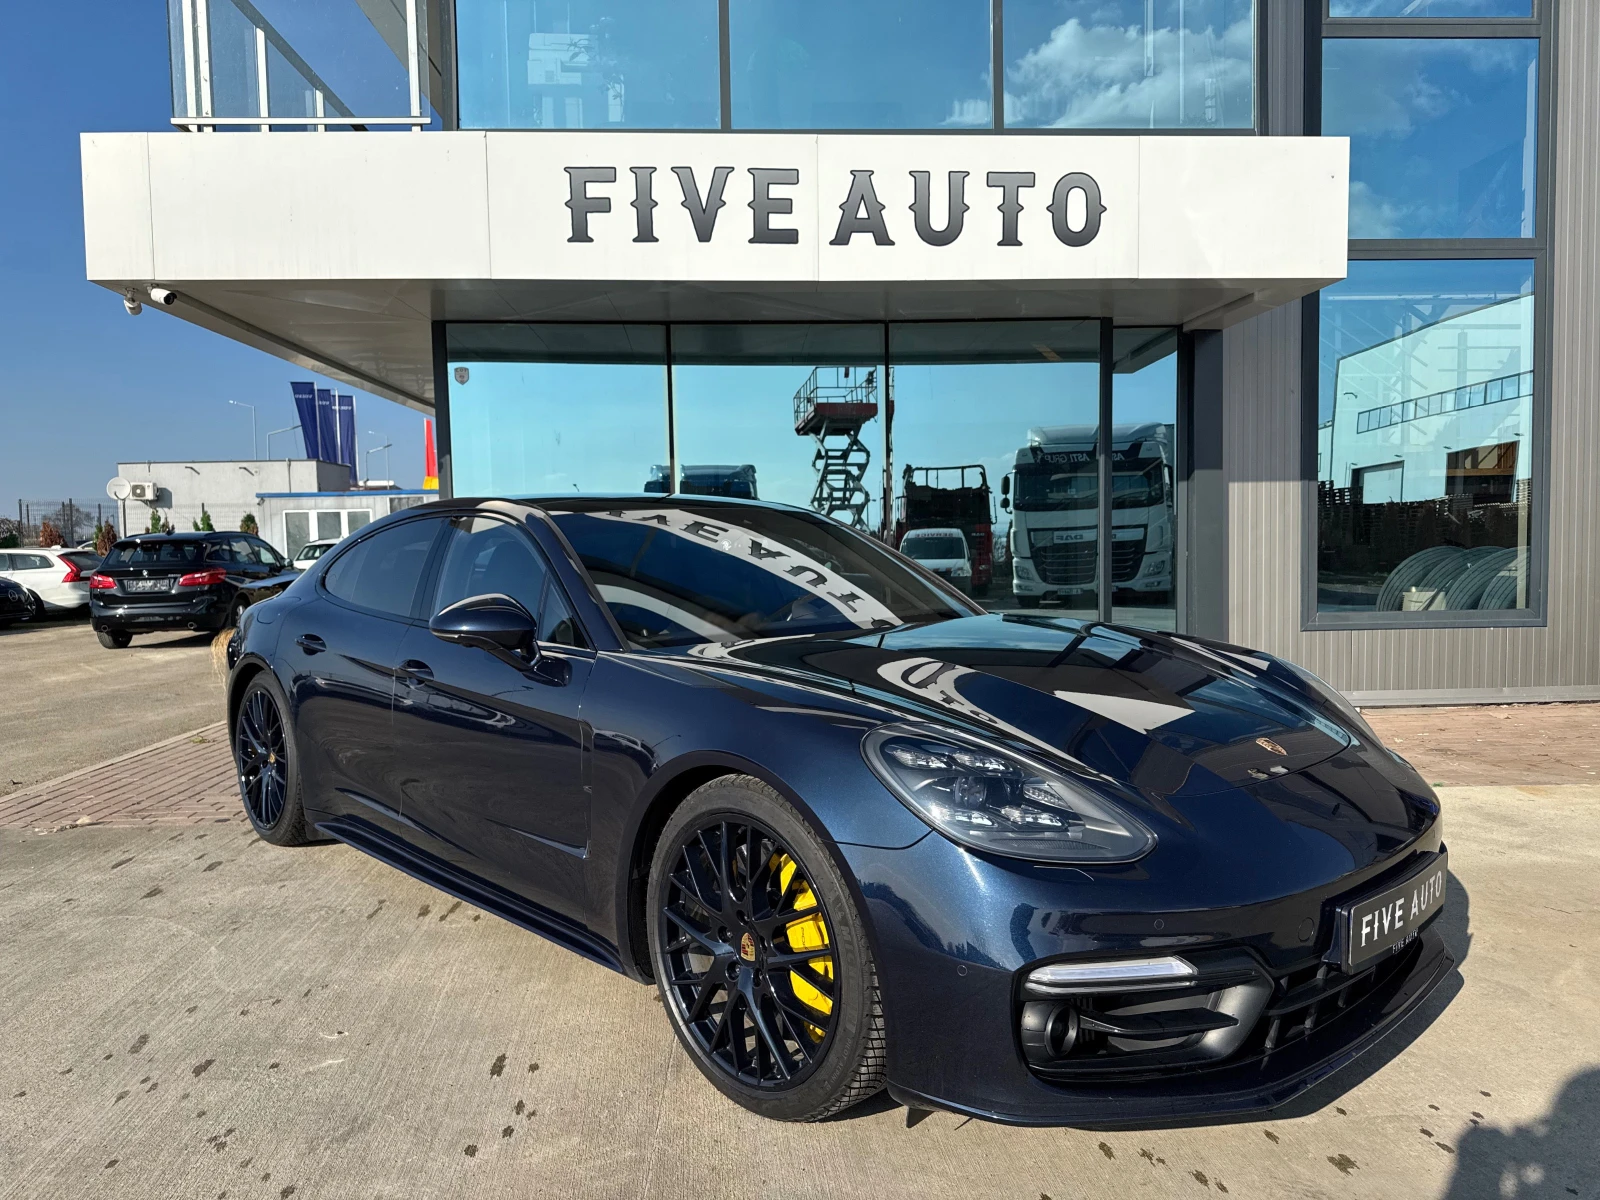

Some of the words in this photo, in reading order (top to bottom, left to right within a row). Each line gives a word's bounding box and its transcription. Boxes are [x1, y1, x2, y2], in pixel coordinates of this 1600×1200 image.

[564, 166, 799, 244] FIVE
[829, 170, 1107, 247] AUTO
[1360, 897, 1405, 948] FIVE
[1409, 870, 1442, 921] AUTO
